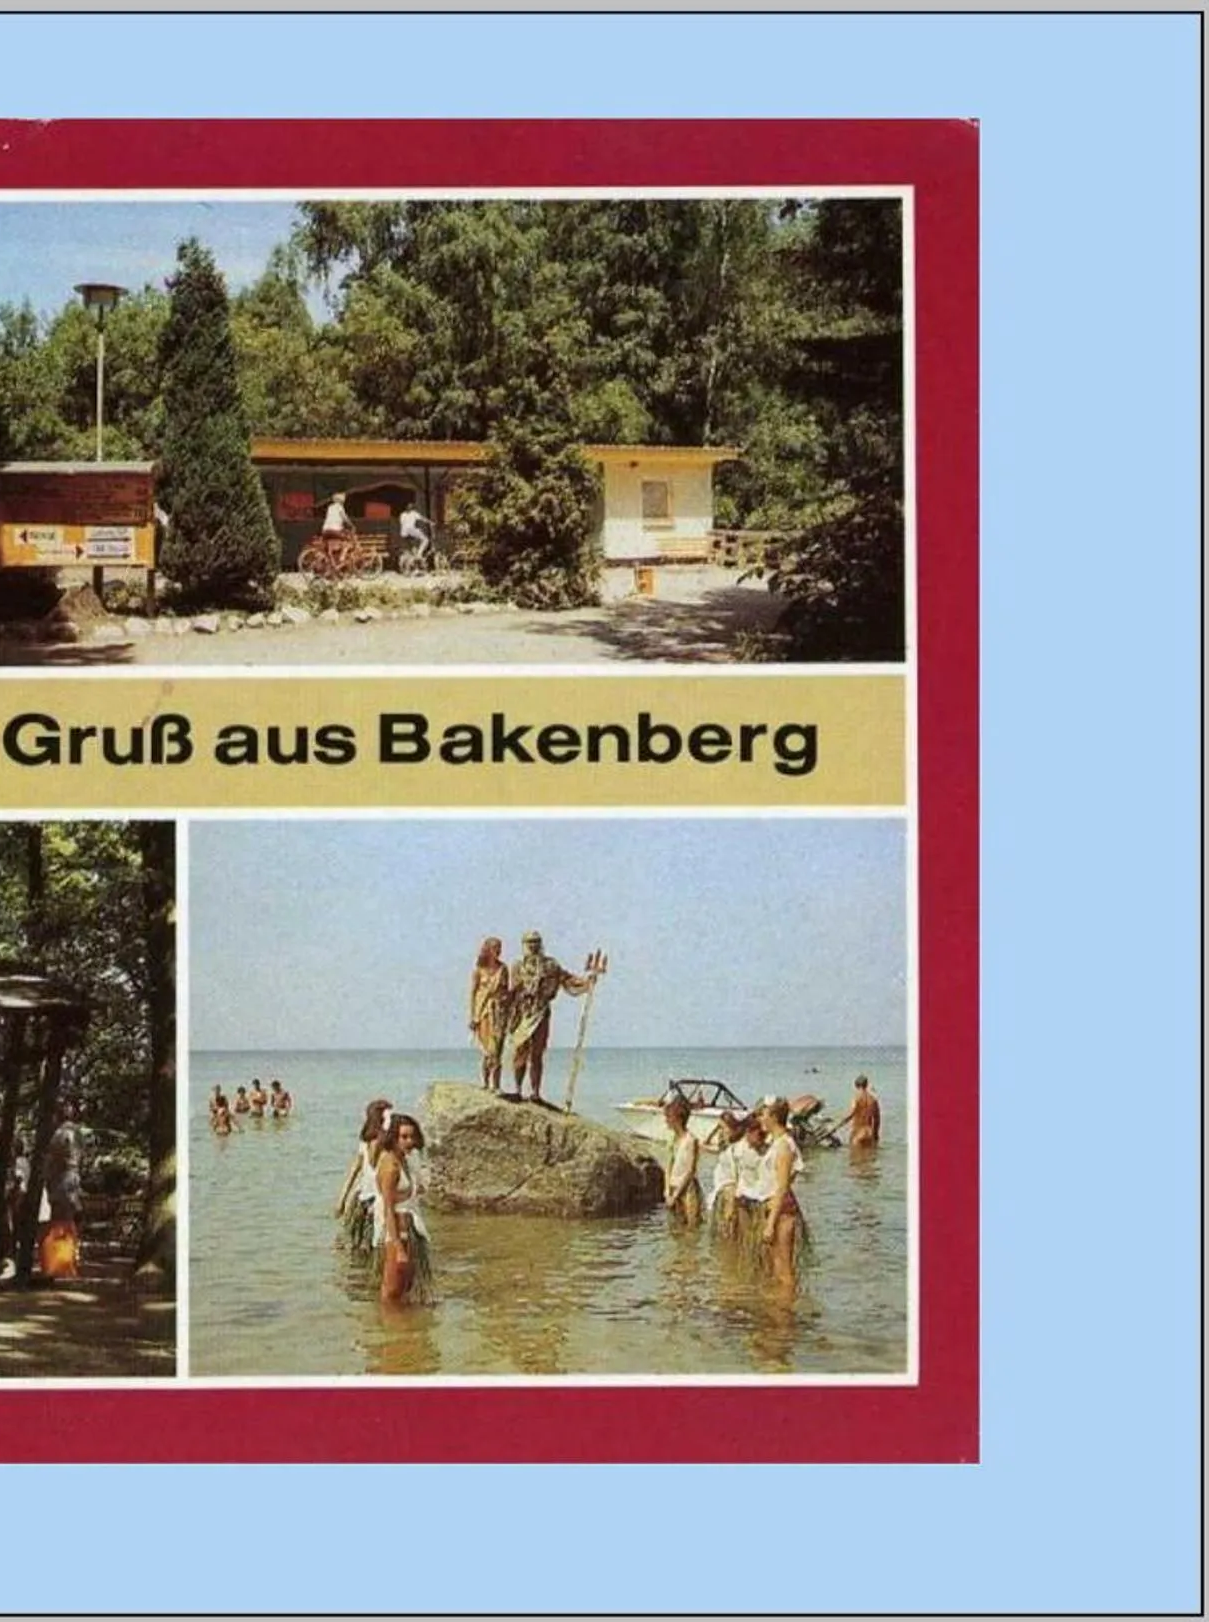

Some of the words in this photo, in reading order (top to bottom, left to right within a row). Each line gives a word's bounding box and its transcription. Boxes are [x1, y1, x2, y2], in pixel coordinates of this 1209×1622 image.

[2, 713, 193, 765] Gruß
[214, 724, 357, 765] aus
[379, 712, 818, 777] Bakenberg
